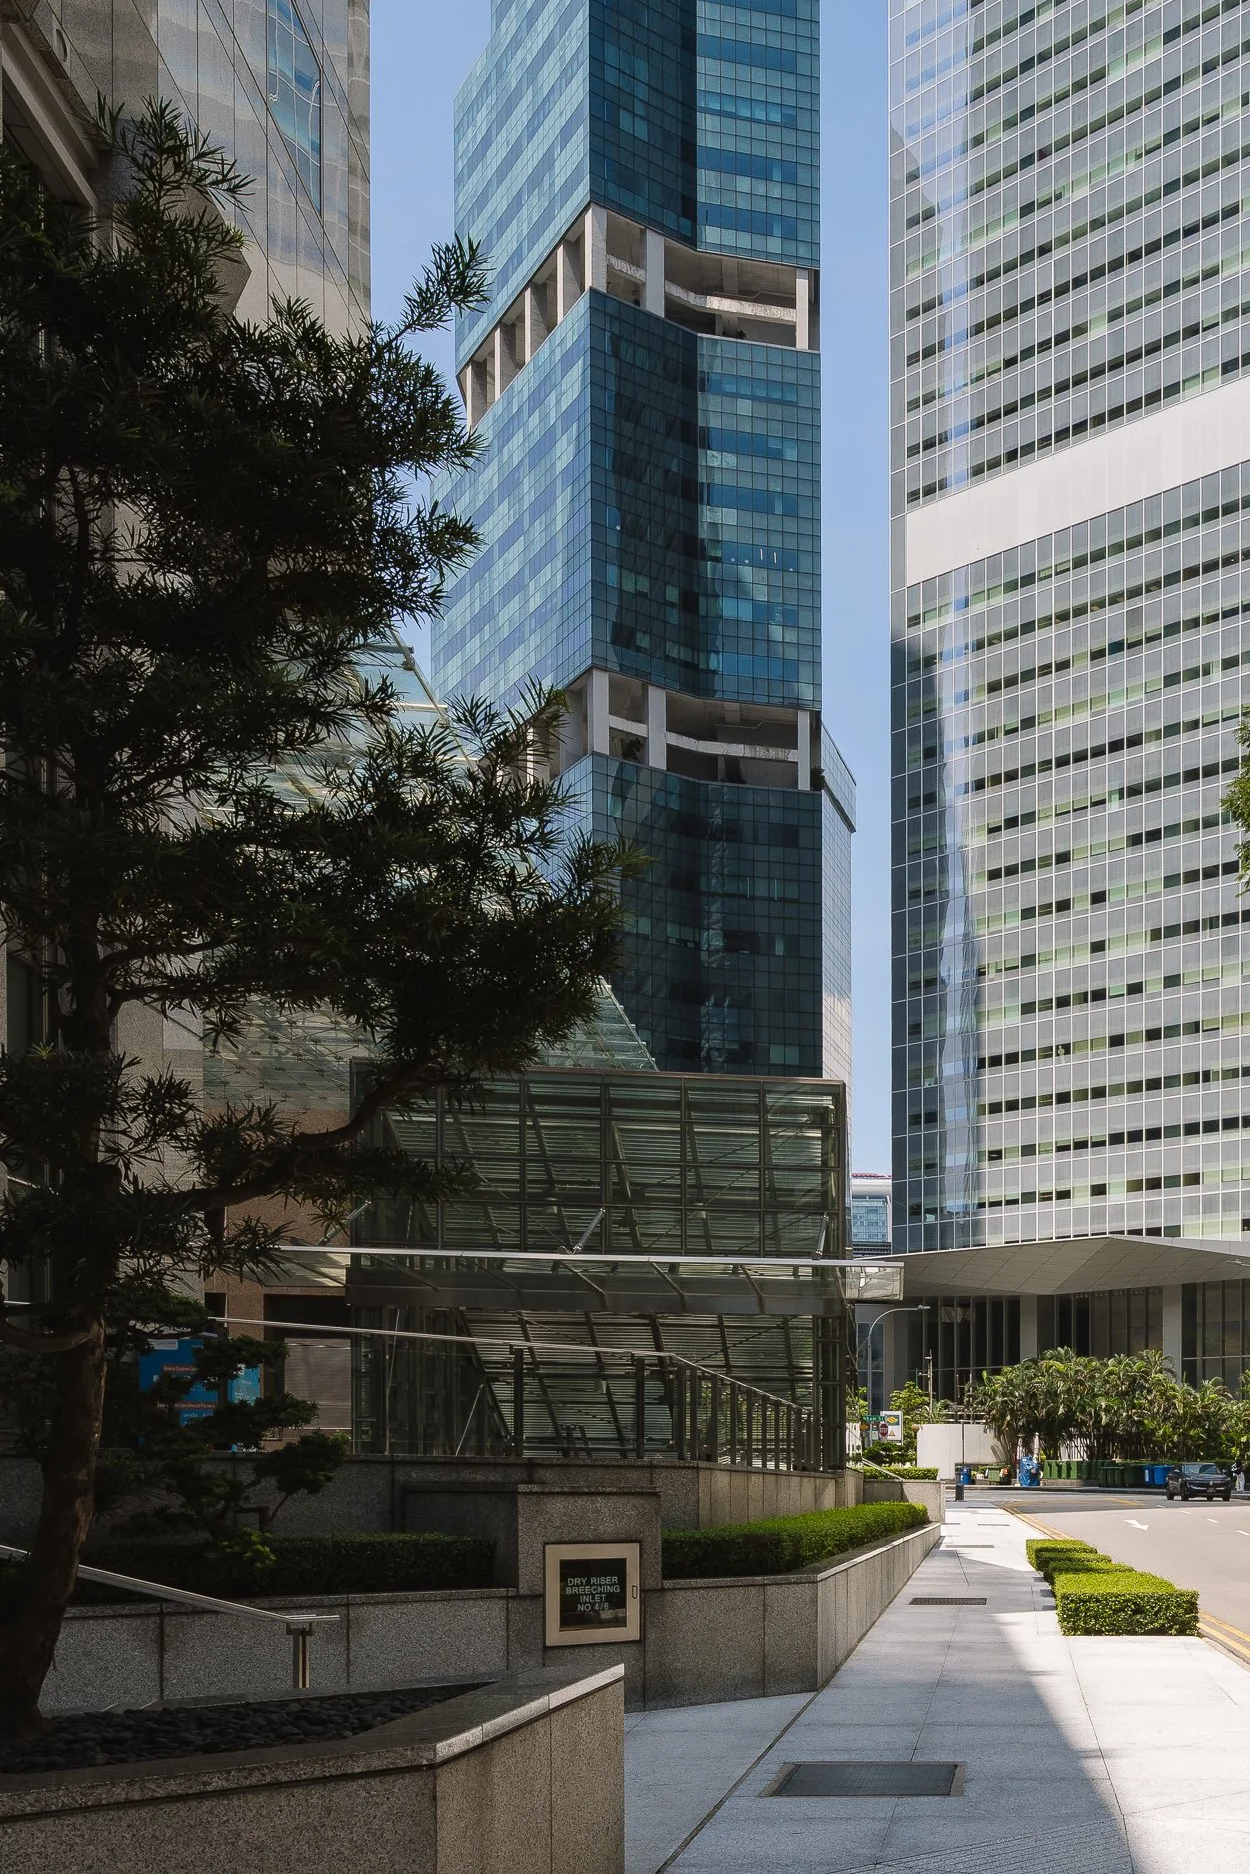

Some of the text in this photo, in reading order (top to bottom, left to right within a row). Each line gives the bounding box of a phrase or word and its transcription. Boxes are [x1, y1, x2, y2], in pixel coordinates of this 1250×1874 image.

[567, 1576, 618, 1586] DRY RISER
[565, 1585, 620, 1594] BREECHING
[579, 1594, 606, 1603] INLET
[577, 1602, 609, 1611] NO 4/6
